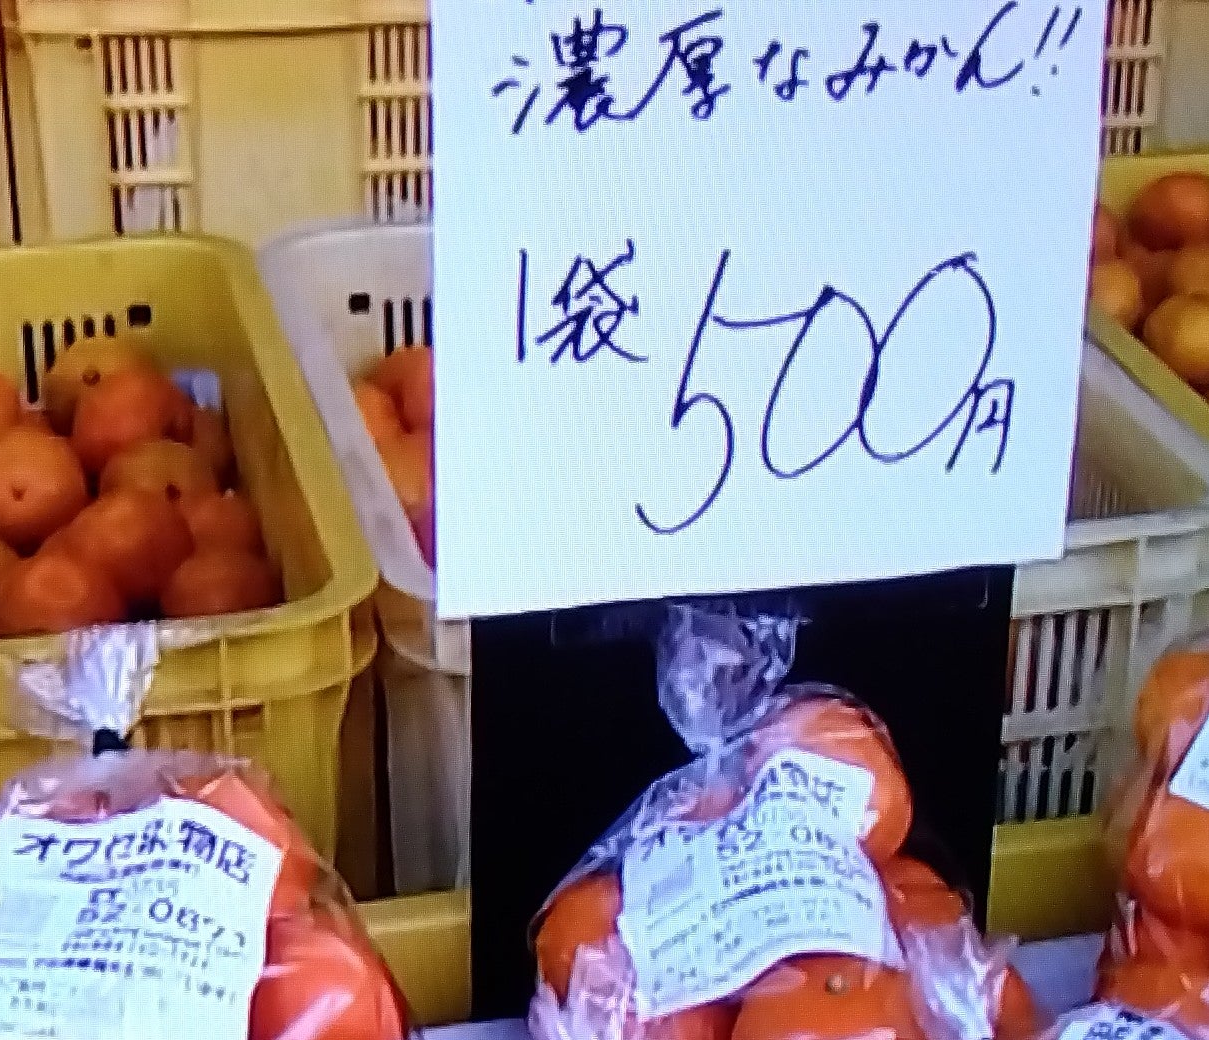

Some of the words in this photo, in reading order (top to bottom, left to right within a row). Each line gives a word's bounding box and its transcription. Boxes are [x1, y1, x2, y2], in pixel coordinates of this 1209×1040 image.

[492, 1, 1082, 134] 濃厚なみかん!!
[636, 249, 1016, 534] 500円
